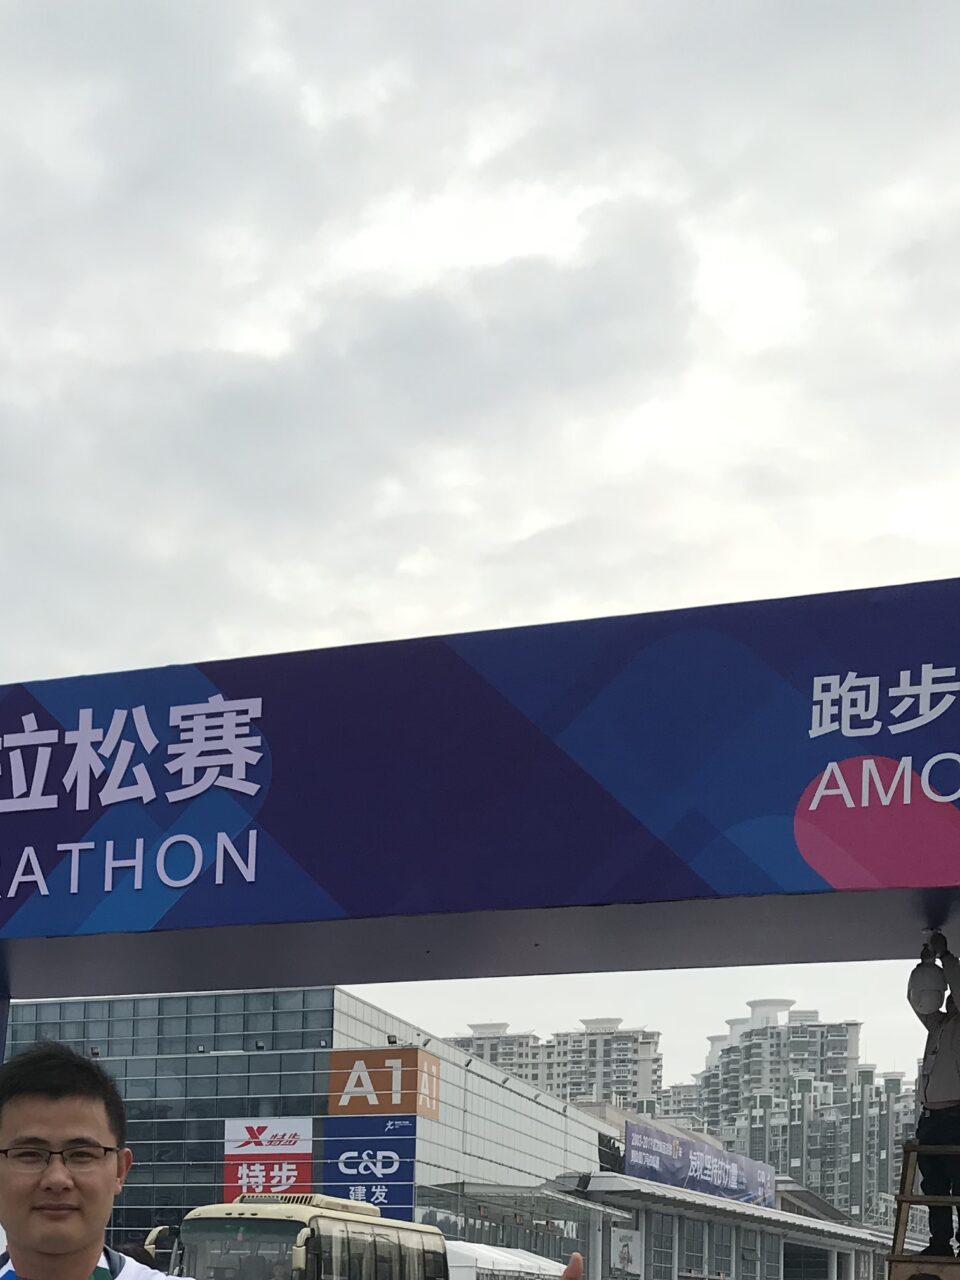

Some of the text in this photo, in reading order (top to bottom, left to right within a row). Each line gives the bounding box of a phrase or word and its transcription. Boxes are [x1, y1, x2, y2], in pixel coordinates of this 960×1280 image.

[808, 663, 960, 739] 跑步
[338, 1058, 402, 1106] A1
[419, 1060, 437, 1110] A1
[238, 1162, 298, 1193] 特步
[338, 1150, 400, 1178] C&D
[349, 1185, 389, 1204] 建发
